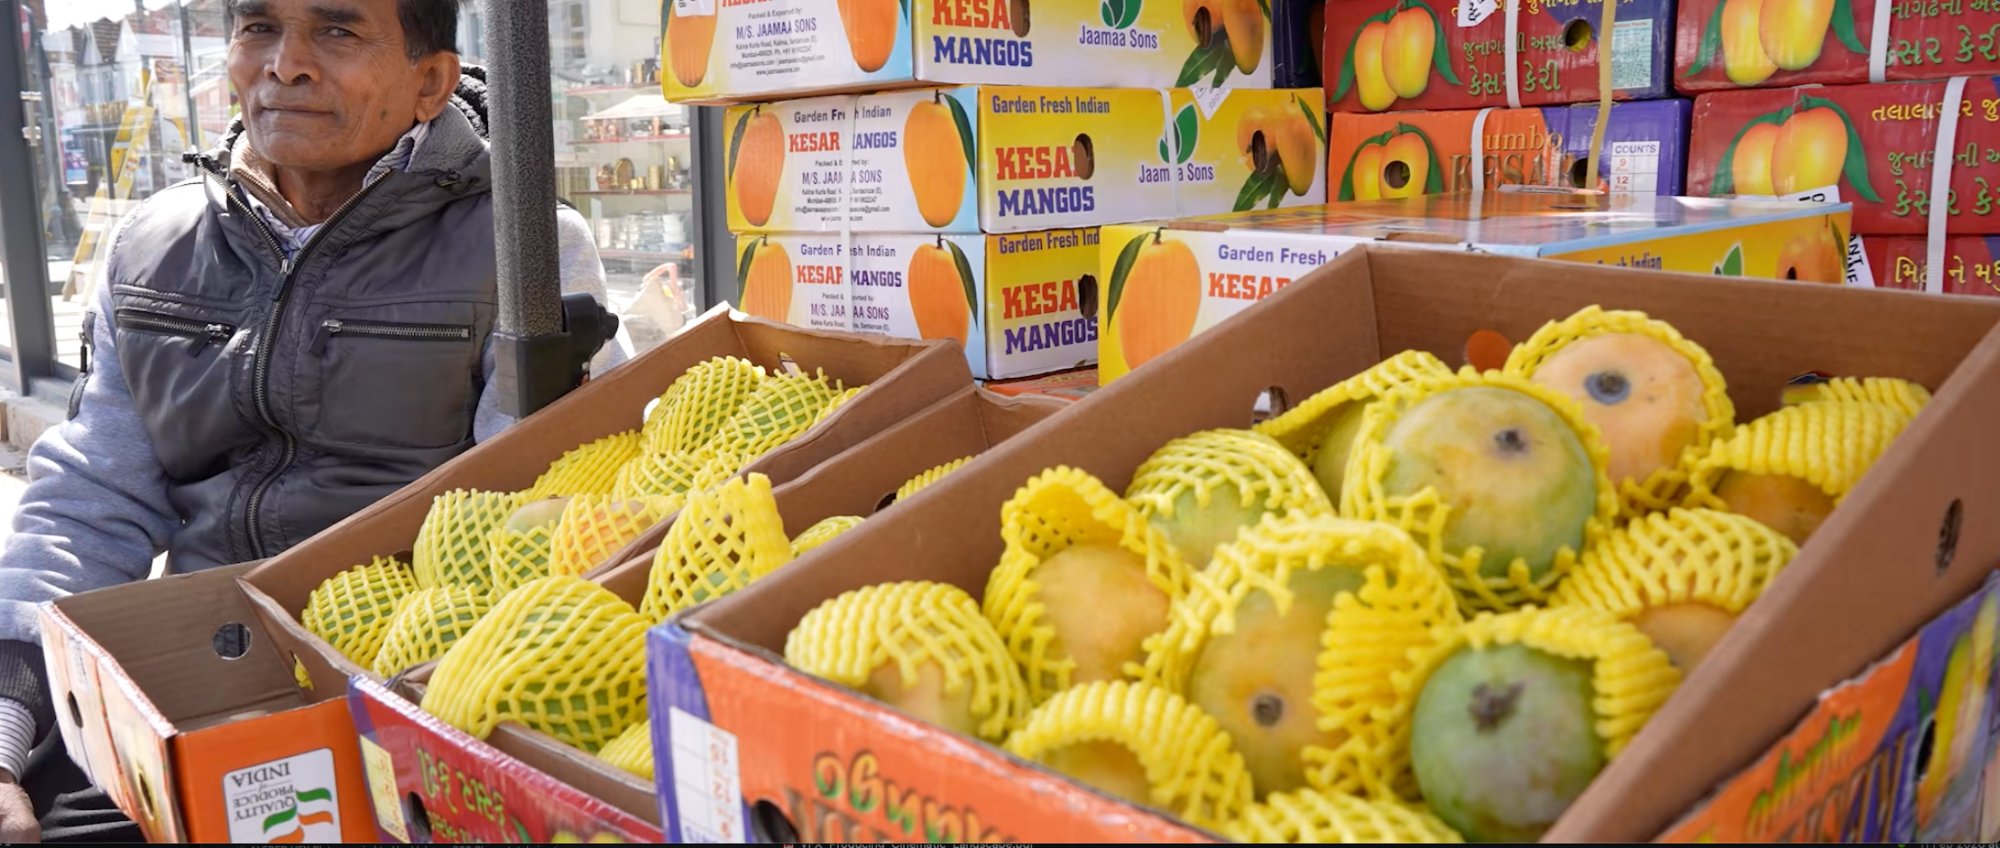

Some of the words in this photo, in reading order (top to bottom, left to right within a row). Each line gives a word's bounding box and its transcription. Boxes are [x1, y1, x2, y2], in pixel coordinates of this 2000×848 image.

[932, 0, 1011, 29] KESA
[757, 21, 792, 37] JAAMAA
[794, 17, 817, 33] SONS
[1079, 25, 1126, 46] Jaamaa
[1129, 29, 1158, 49] Sons
[933, 35, 1033, 67] MANGOS
[1467, 64, 1506, 96] કેસ
[1522, 59, 1561, 92] કેરી
[794, 110, 828, 123] Garden
[831, 105, 859, 121] Frh
[862, 105, 892, 119] Indian
[994, 95, 1036, 113] Garden
[1040, 97, 1072, 113] Fresh
[1076, 97, 1110, 113] Indian
[789, 131, 841, 152] KESAR
[853, 131, 897, 150] ANGOS
[1485, 125, 1563, 152] umbo
[1615, 144, 1656, 154] COUNTS
[996, 146, 1079, 180] KESA
[1139, 165, 1183, 183] Jaama
[1187, 163, 1214, 181] Sons
[1619, 158, 1627, 167] 9
[802, 172, 821, 185] M/S.
[823, 171, 857, 184] JAAA
[859, 169, 882, 183] SONS
[1616, 175, 1629, 184] 12
[998, 186, 1095, 217] MANGOS
[801, 244, 834, 256] Garden
[837, 244, 863, 256] Fsh
[867, 245, 896, 257] Indian
[1000, 233, 1043, 254] Garden
[1047, 229, 1078, 249] Fresh
[1082, 228, 1099, 245] Ind
[1218, 244, 1273, 263] Garden
[1280, 248, 1327, 265] Fresh
[851, 270, 902, 288] MANGOS
[1002, 280, 1078, 320] KESA
[811, 303, 829, 317] M/S.
[831, 305, 865, 319] JAAAA
[867, 306, 890, 320] SONS
[1004, 316, 1099, 355] MANGOS
[231, 762, 291, 788] INDIA
[233, 784, 294, 809] PRODUCE
[237, 796, 296, 820] QUALITY
